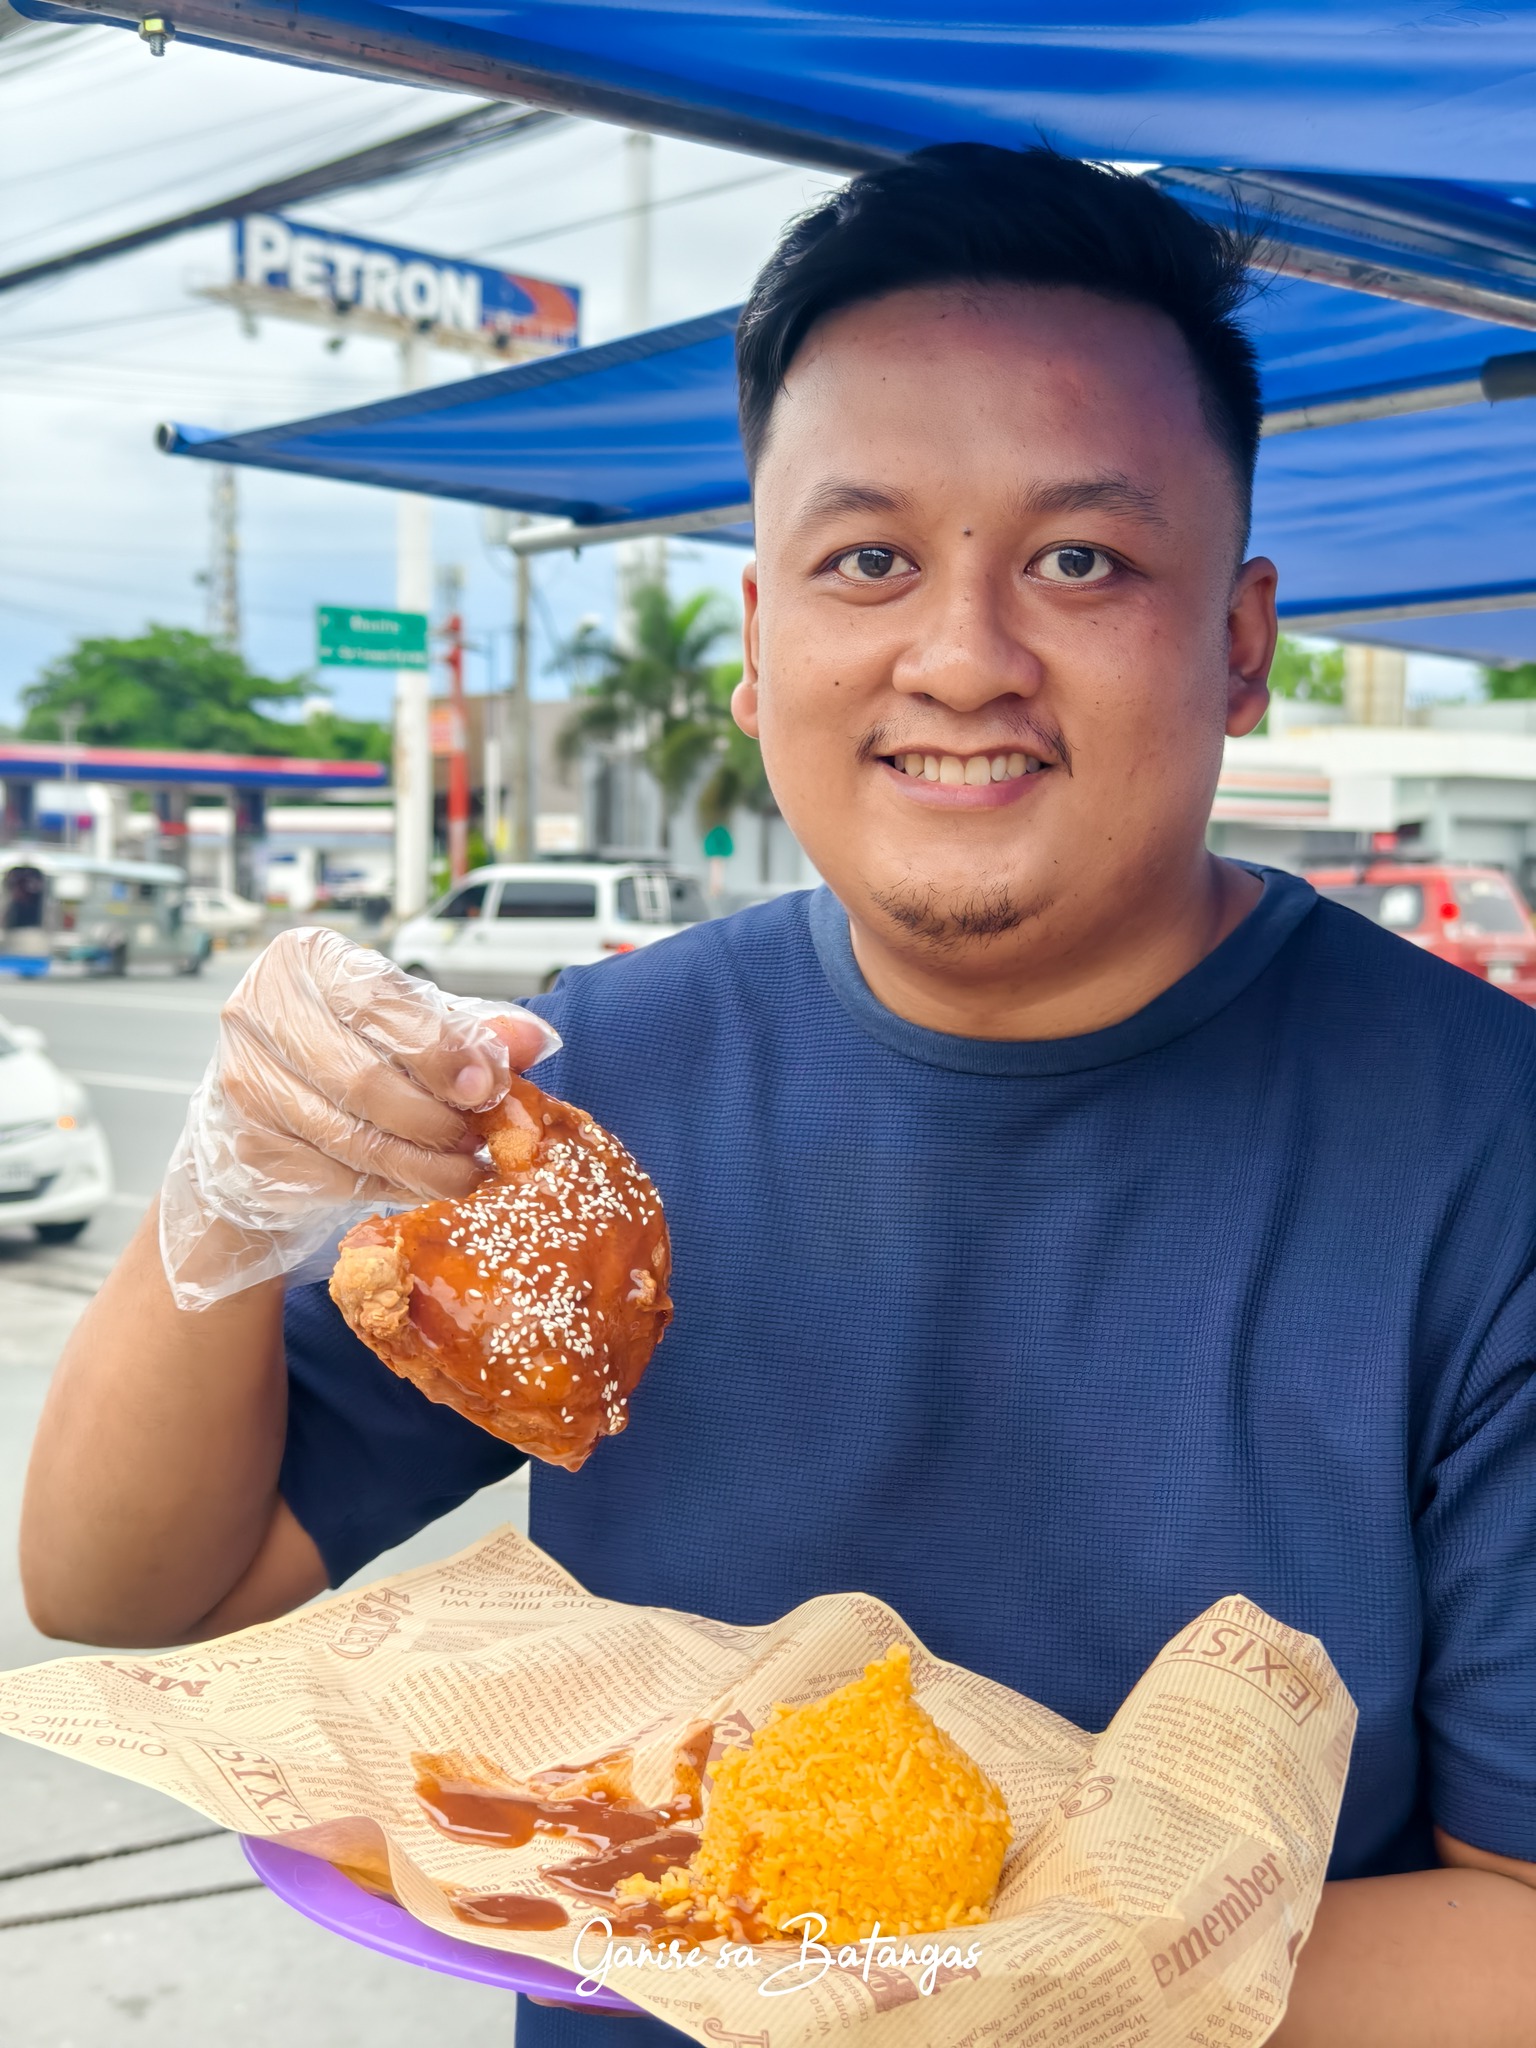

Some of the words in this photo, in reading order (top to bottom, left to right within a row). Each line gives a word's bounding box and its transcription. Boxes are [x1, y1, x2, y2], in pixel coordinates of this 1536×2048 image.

[243, 214, 482, 328] PETRON
[431, 1664, 450, 1684] with
[505, 1668, 517, 1680] in
[530, 1660, 552, 1685] Could
[548, 1661, 570, 1686] never
[1168, 1625, 1312, 1712] EXIST
[386, 1680, 399, 1694] be
[446, 1682, 463, 1701] Bear
[492, 1675, 522, 1710] Should
[530, 1684, 544, 1699] be
[569, 1670, 591, 1695] there
[611, 1684, 622, 1696] in
[395, 1691, 406, 1703] to
[413, 1689, 439, 1719] having
[464, 1682, 490, 1713] having
[486, 1691, 497, 1701] it
[512, 1681, 538, 1710] When
[567, 1688, 583, 1706] two
[584, 1691, 595, 1702] If
[619, 1693, 640, 1715] hand
[491, 1699, 506, 1714] let
[538, 1696, 566, 1729] Should
[567, 1710, 576, 1720] is
[580, 1707, 594, 1722] for
[401, 1700, 439, 1748] Remember
[449, 1712, 462, 1726] be
[481, 1710, 505, 1738] When
[500, 1711, 512, 1723] to
[1191, 1712, 1212, 1727] the
[432, 1716, 456, 1745] When
[458, 1725, 469, 1736] to
[571, 1718, 594, 1742] there
[1188, 1725, 1212, 1742] real
[484, 1741, 496, 1753] in
[506, 1722, 543, 1768] Remember
[533, 1736, 549, 1754] bad
[1153, 1738, 1183, 1757] each
[1214, 1736, 1245, 1755] most
[546, 1751, 557, 1762] in
[1125, 1755, 1158, 1776] every
[1183, 1748, 1232, 1778] missing
[1214, 1750, 1265, 1781] practical
[287, 1761, 313, 1773] with
[1155, 1769, 1183, 1789] ones
[1180, 1782, 1227, 1810] beloved
[1223, 1802, 1239, 1816] of
[1237, 1808, 1269, 1830] faces
[1144, 1871, 1167, 1887] bad
[1150, 1852, 1286, 1988] emember
[1074, 1924, 1107, 1951] where
[1058, 1943, 1077, 1959] we
[1034, 1953, 1063, 1979] look
[1015, 1970, 1038, 1991] for
[1027, 1977, 1064, 2003] home
[1113, 1975, 1140, 1996] and
[1066, 1984, 1089, 2003] On
[1075, 1990, 1113, 2016] share
[1123, 1992, 1144, 2009] we
[1045, 1996, 1068, 2016] the
[1100, 2003, 1125, 2024] first
[1050, 2013, 1074, 2032] the
[1068, 2016, 1100, 2039] want
[1108, 2011, 1147, 2037] When
[1056, 2034, 1070, 2047] to
[1089, 2030, 1109, 2045] we
[1226, 2022, 1254, 2044] each
